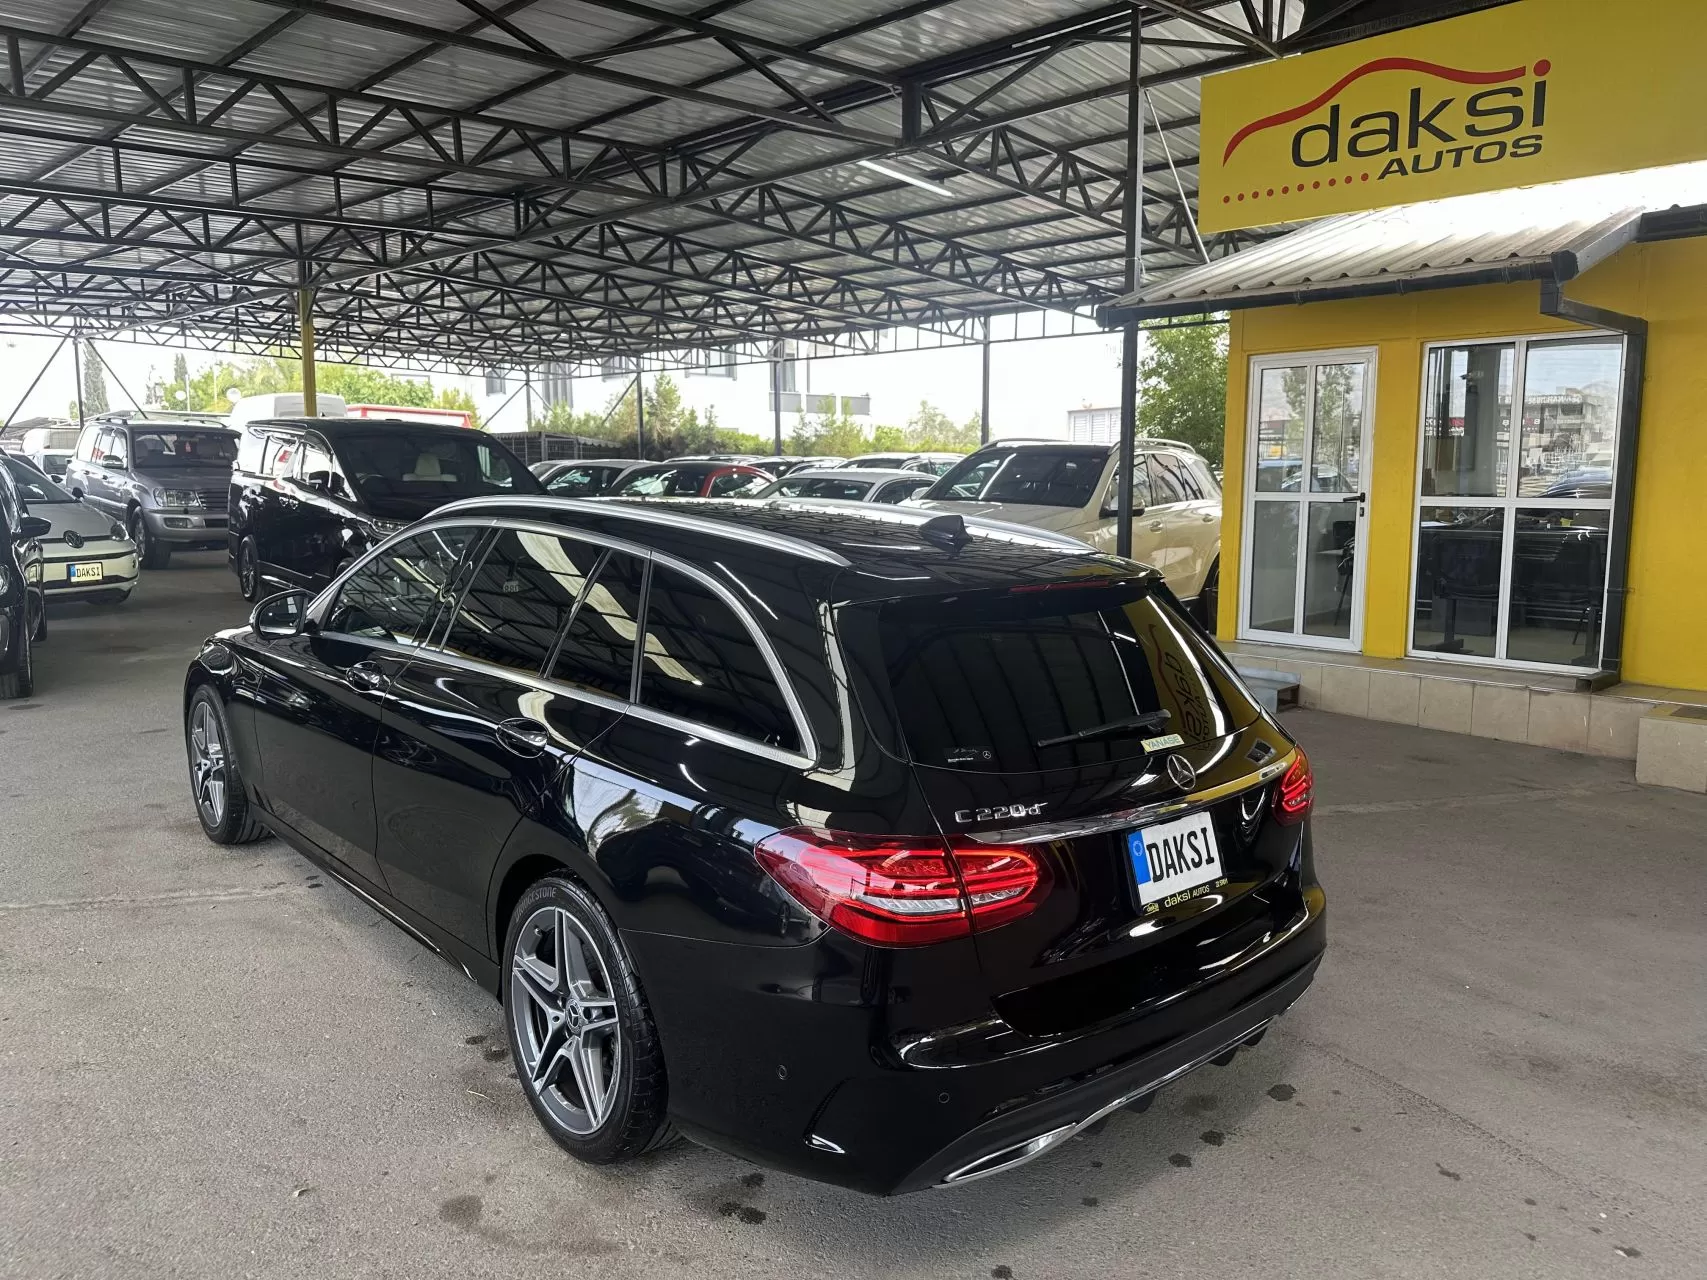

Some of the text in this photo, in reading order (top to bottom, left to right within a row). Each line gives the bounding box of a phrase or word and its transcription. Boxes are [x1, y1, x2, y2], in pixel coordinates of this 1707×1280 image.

[1290, 58, 1552, 168] daksi
[1376, 134, 1543, 181] AUTOS
[76, 566, 101, 578] DAKSI
[1144, 735, 1181, 749] YANASE
[954, 802, 1048, 823] C 220d
[1146, 826, 1215, 883] DAKSI
[1164, 884, 1210, 908] daksi AUTOS
